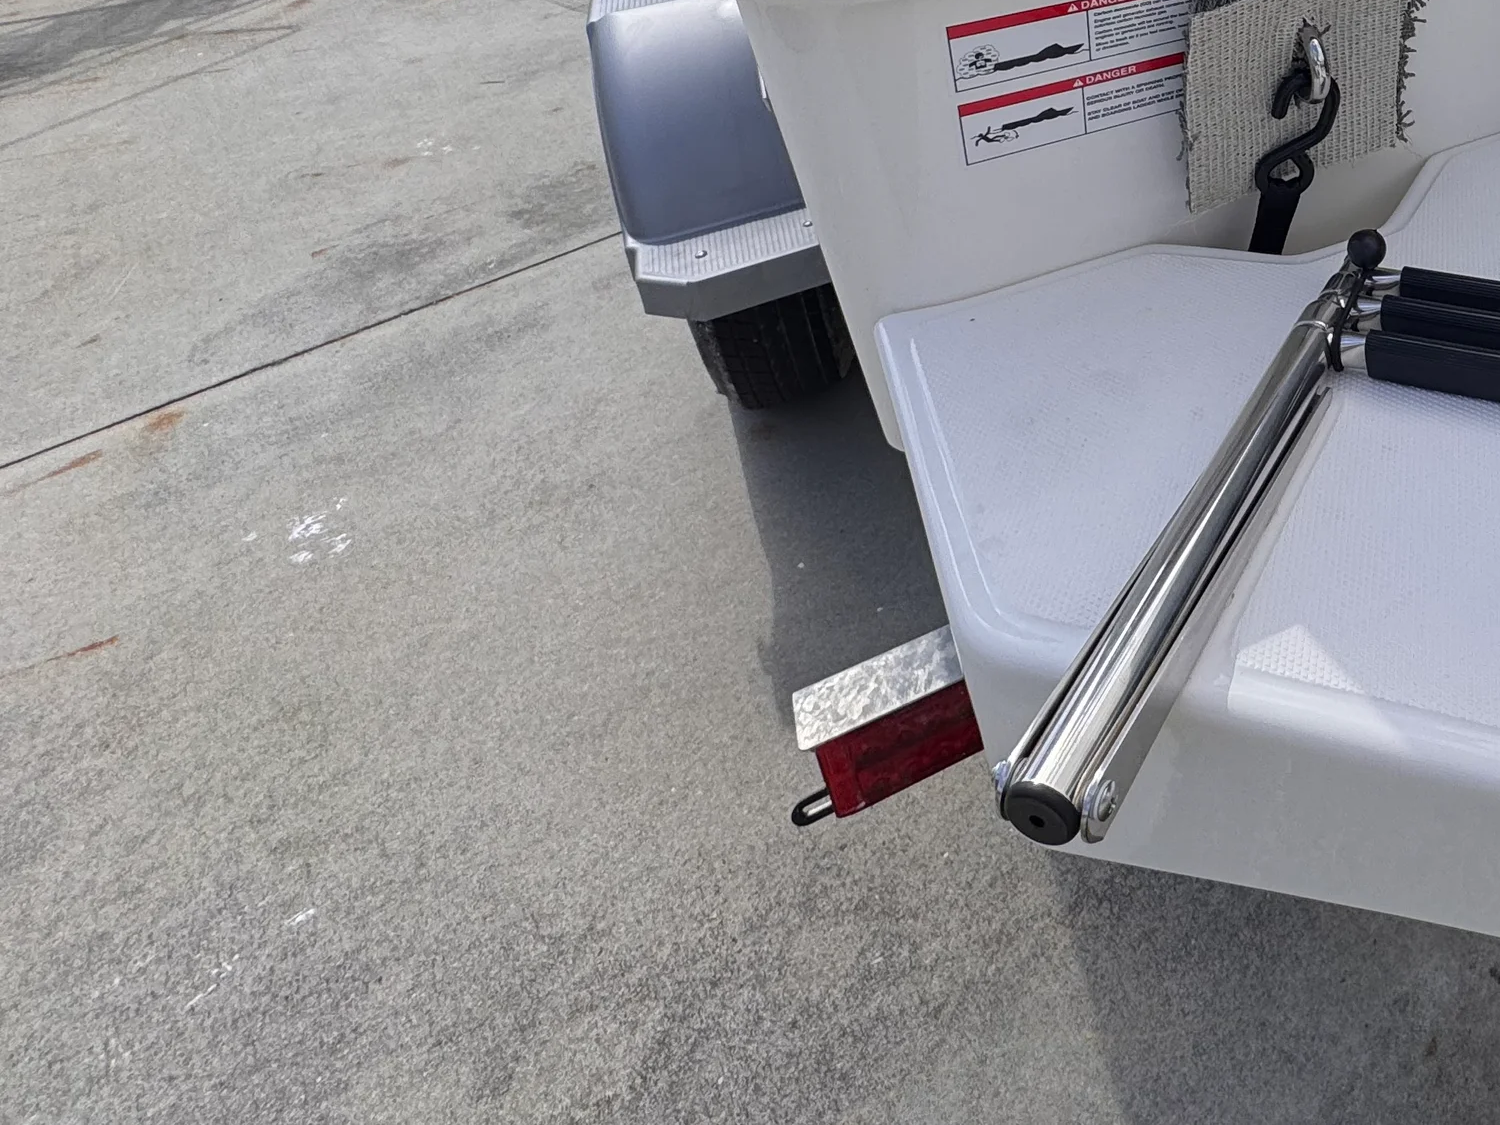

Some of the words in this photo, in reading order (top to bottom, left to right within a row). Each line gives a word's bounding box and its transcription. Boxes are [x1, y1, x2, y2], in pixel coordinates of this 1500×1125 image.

[1086, 65, 1137, 85] DANGER
[1086, 90, 1114, 101] CONTACT
[1115, 86, 1131, 94] WITH
[1136, 78, 1164, 89] SPINNING
[1087, 96, 1113, 106] SERIOUS
[1113, 91, 1135, 100] INJURY
[1102, 103, 1122, 112] CLEAR
[1132, 96, 1148, 105] BOAT
